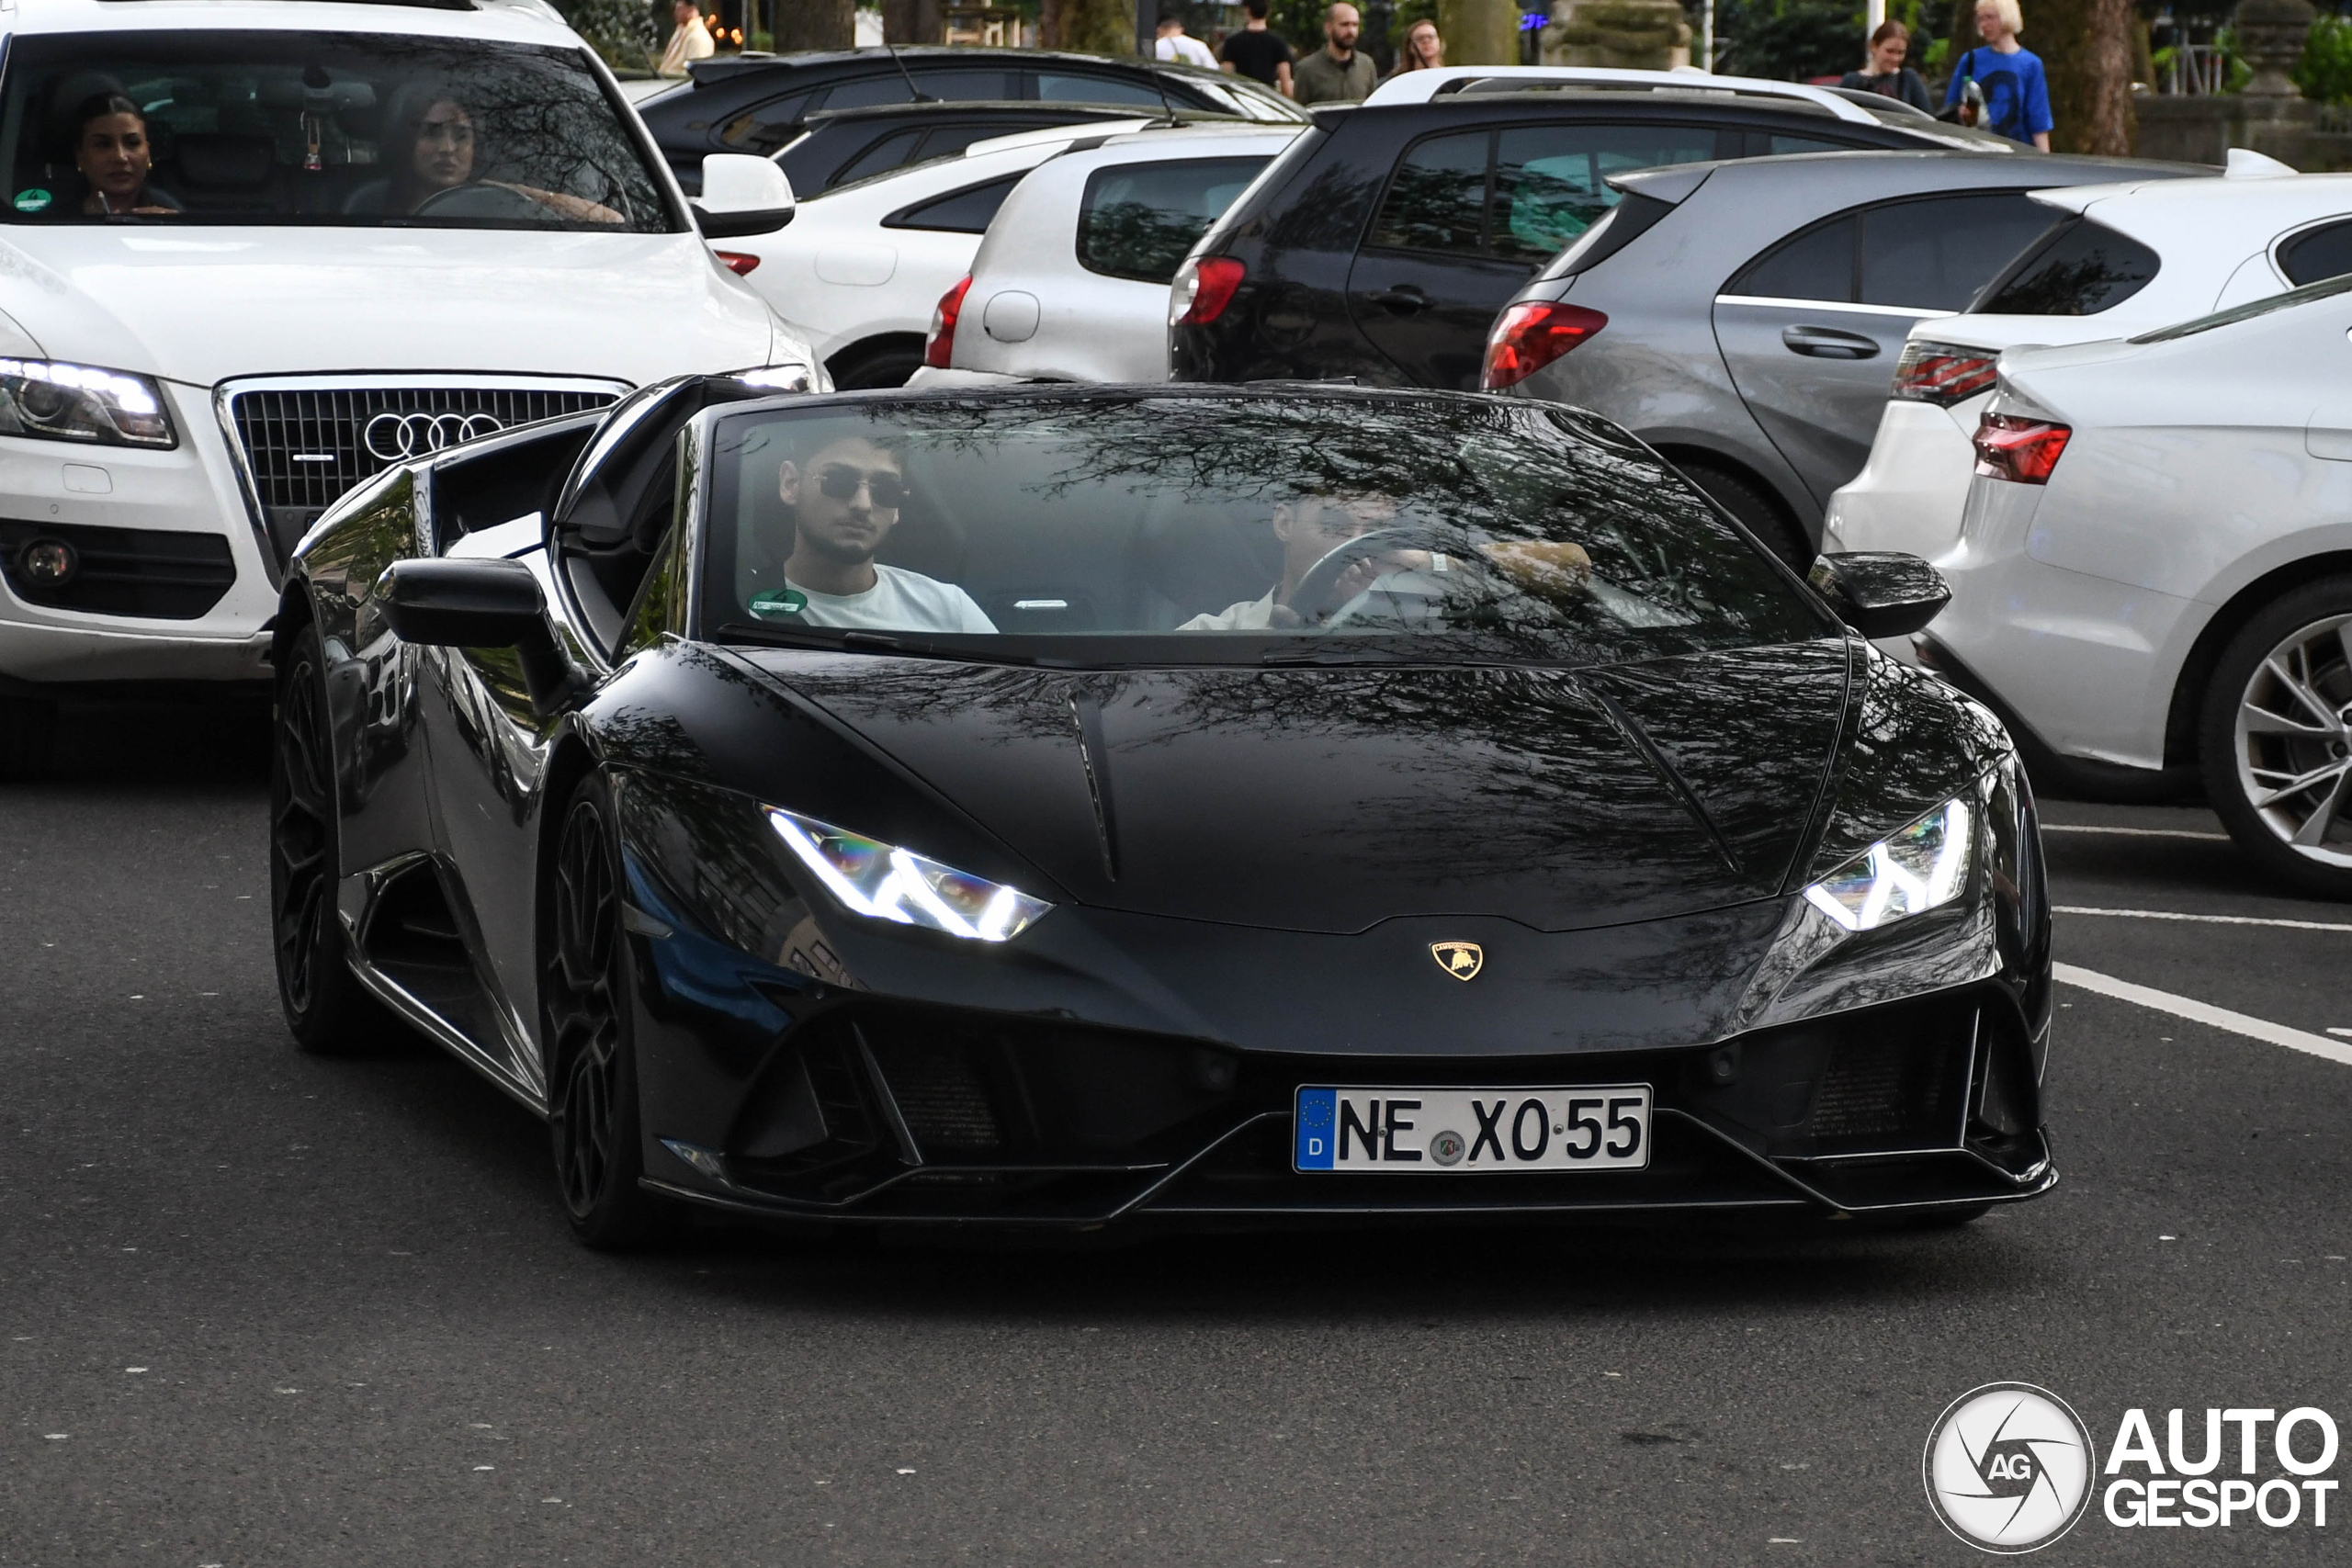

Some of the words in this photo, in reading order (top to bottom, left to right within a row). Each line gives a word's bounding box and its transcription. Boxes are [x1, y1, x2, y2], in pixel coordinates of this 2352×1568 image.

[1309, 1138, 1323, 1156] D
[1339, 1099, 1422, 1161] NE
[1468, 1098, 1550, 1161] XO
[1566, 1097, 1643, 1159] 55
